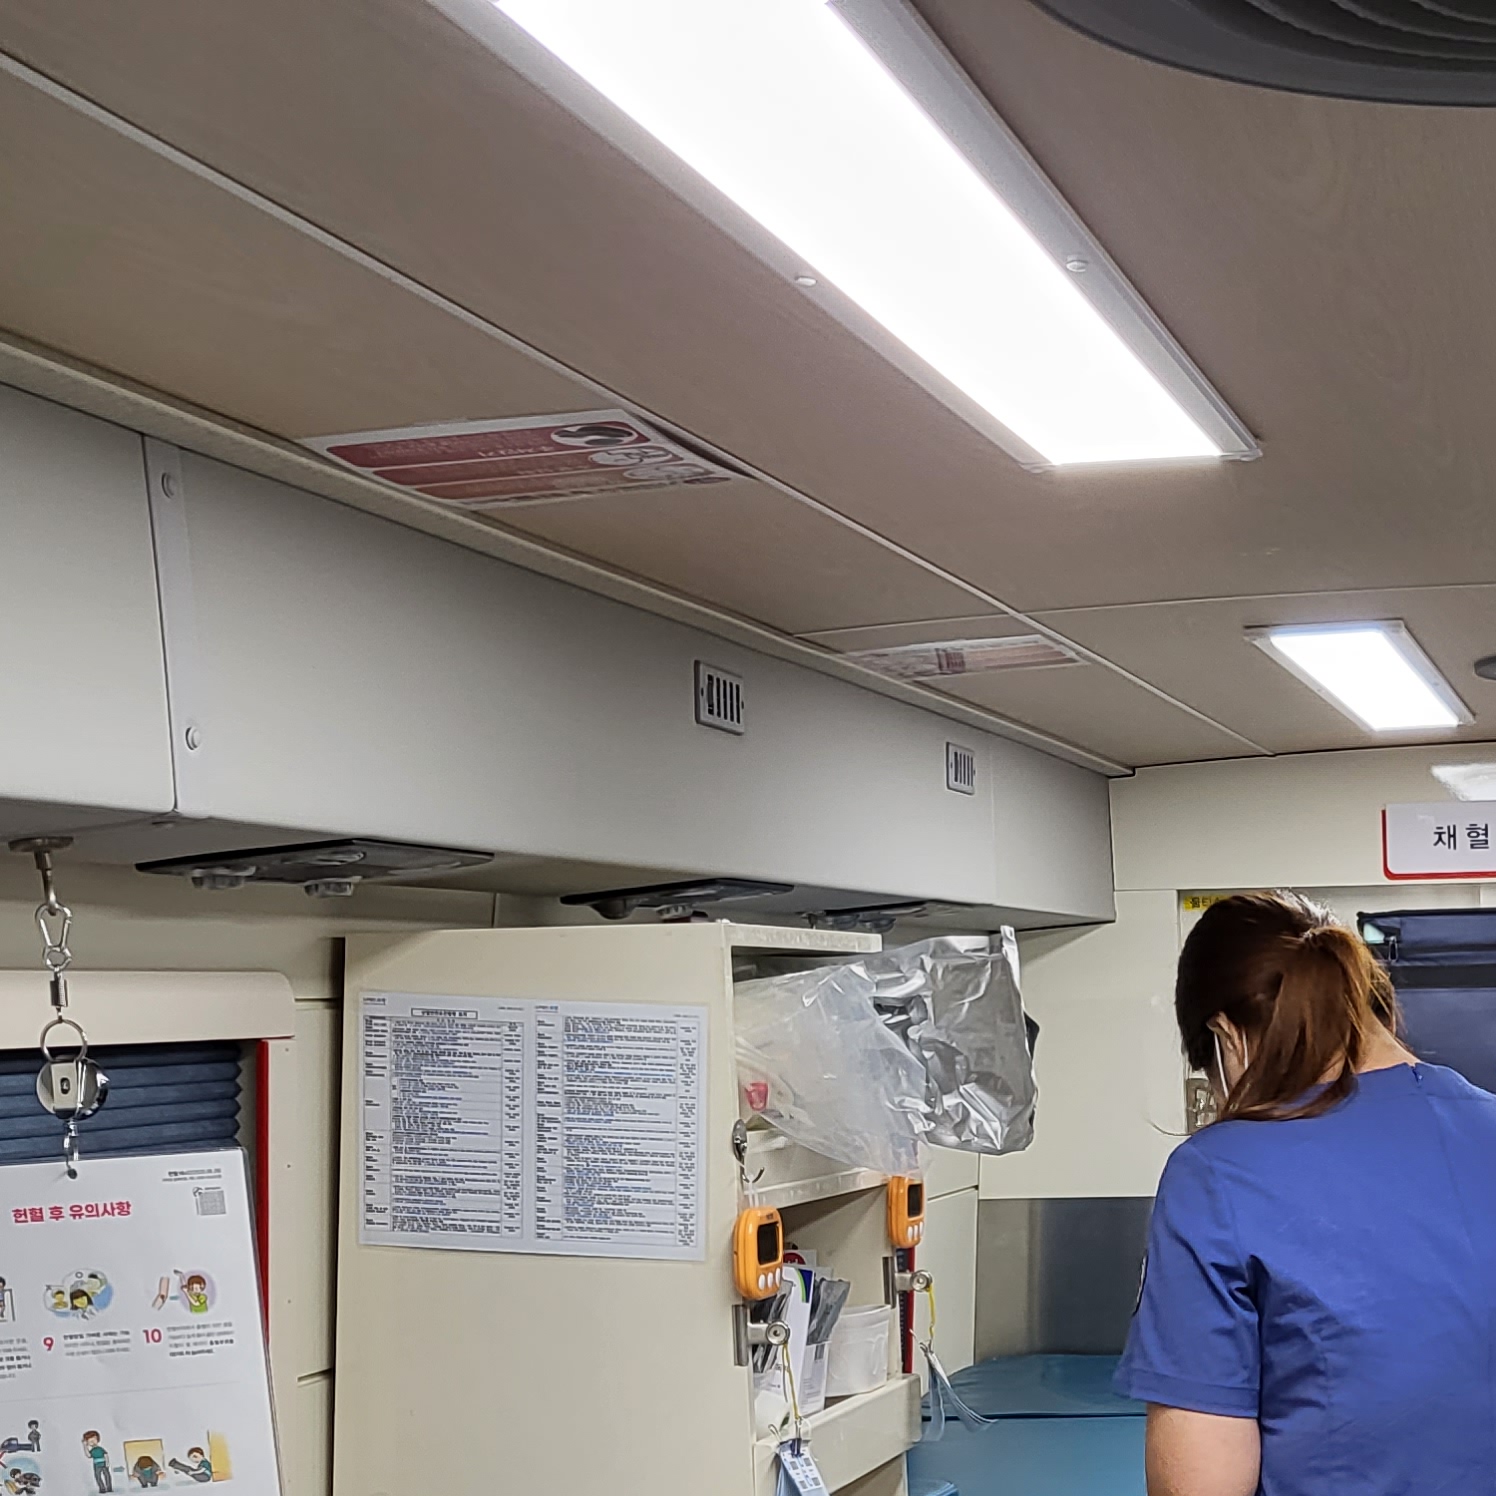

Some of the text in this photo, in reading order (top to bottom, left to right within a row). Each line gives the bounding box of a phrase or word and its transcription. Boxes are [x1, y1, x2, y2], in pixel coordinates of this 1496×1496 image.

[12, 1200, 132, 1223] 헌혈 후 유의사항
[43, 1337, 55, 1351] 9
[143, 1328, 163, 1344] 10
